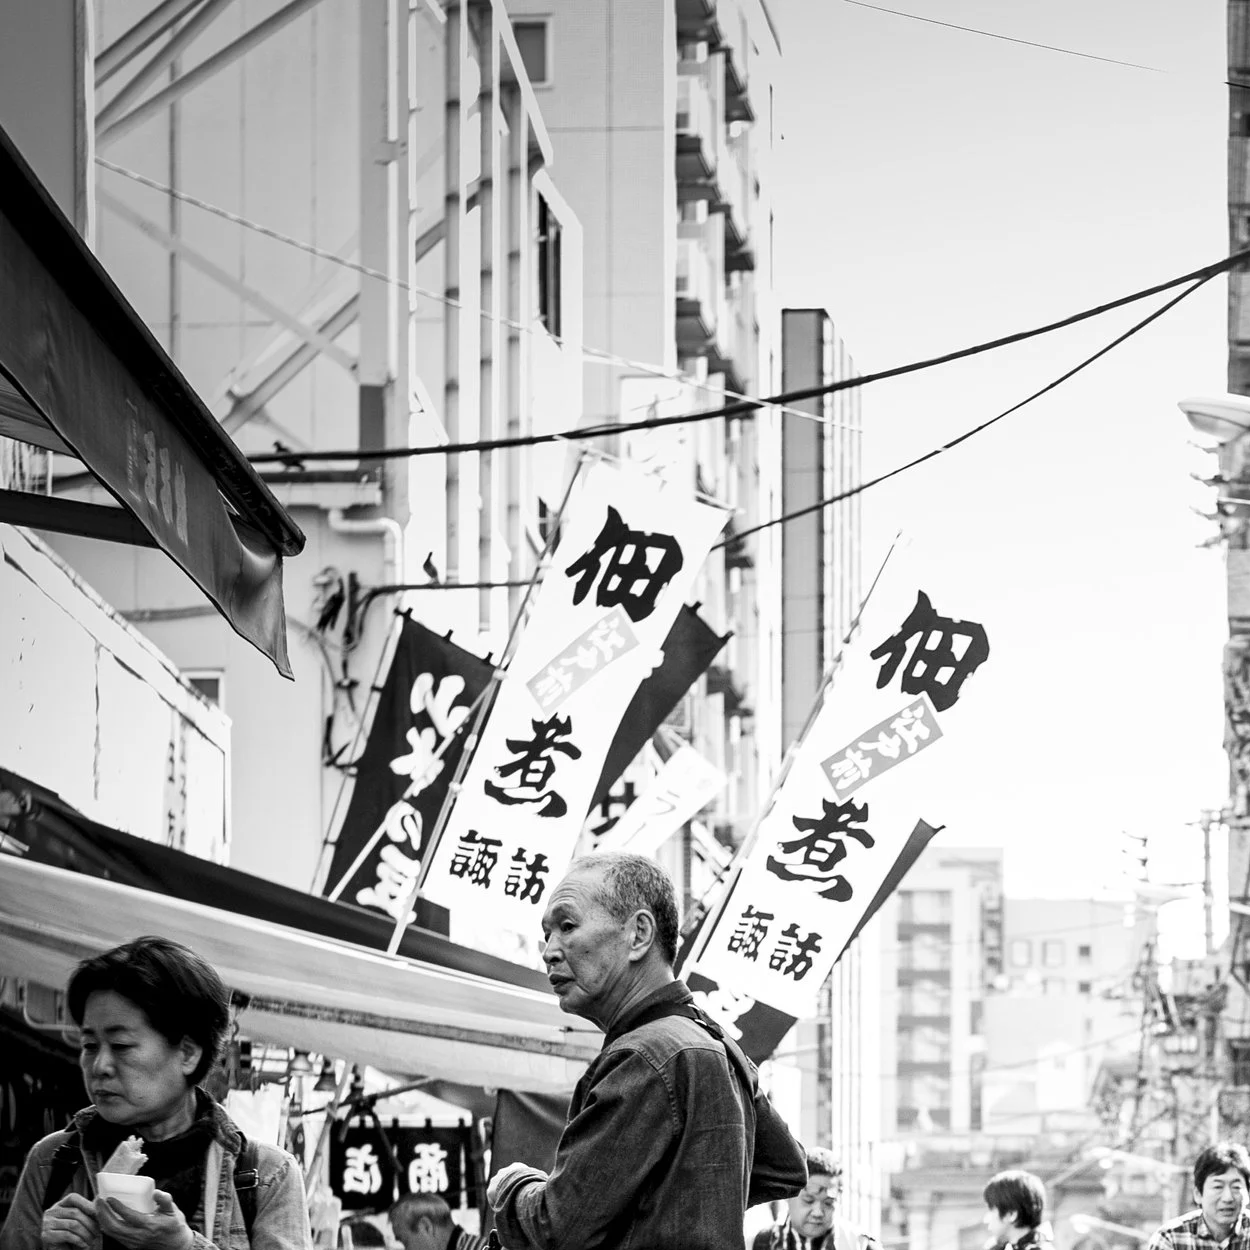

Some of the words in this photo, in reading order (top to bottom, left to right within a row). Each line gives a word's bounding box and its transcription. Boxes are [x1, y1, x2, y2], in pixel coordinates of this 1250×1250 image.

[830, 704, 931, 790] 江戸前
[449, 829, 549, 905] 諏訪
[728, 904, 823, 981] 諏訪
